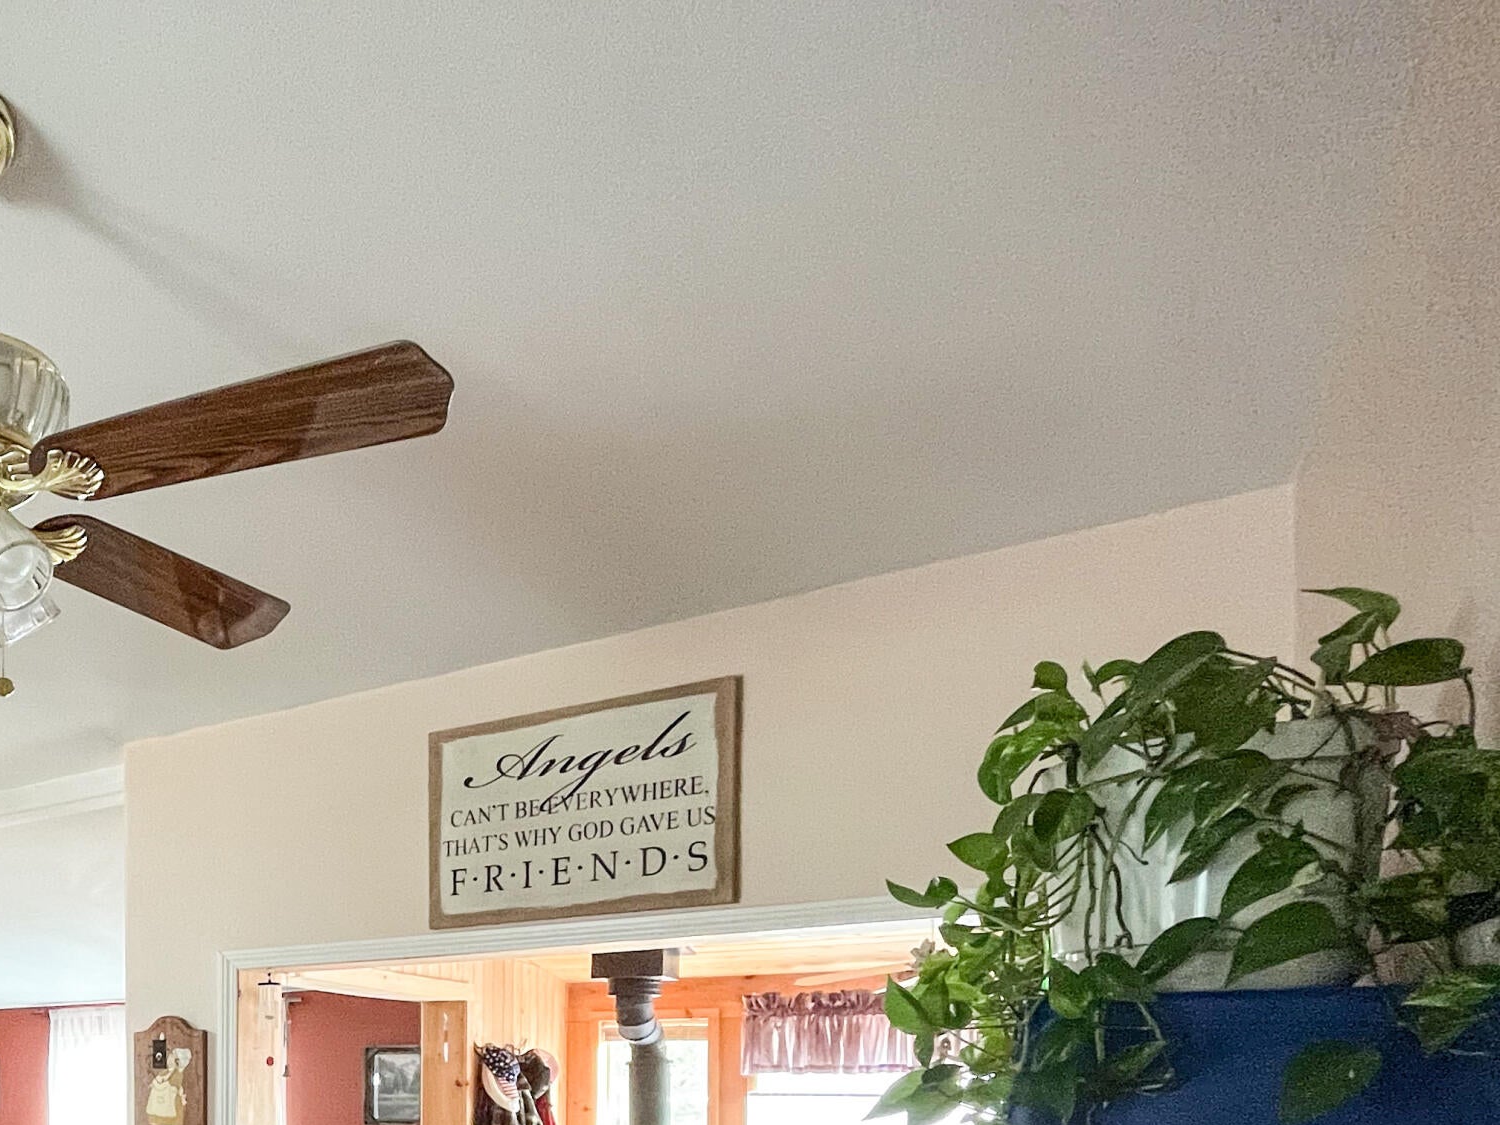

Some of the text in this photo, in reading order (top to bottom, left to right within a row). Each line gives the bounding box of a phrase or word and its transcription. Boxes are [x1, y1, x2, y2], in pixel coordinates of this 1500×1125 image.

[464, 711, 697, 812] Angels
[443, 805, 716, 857] THAT'S WHY GOD GAVE US
[450, 803, 509, 828] CAN'T
[515, 799, 540, 819] BE
